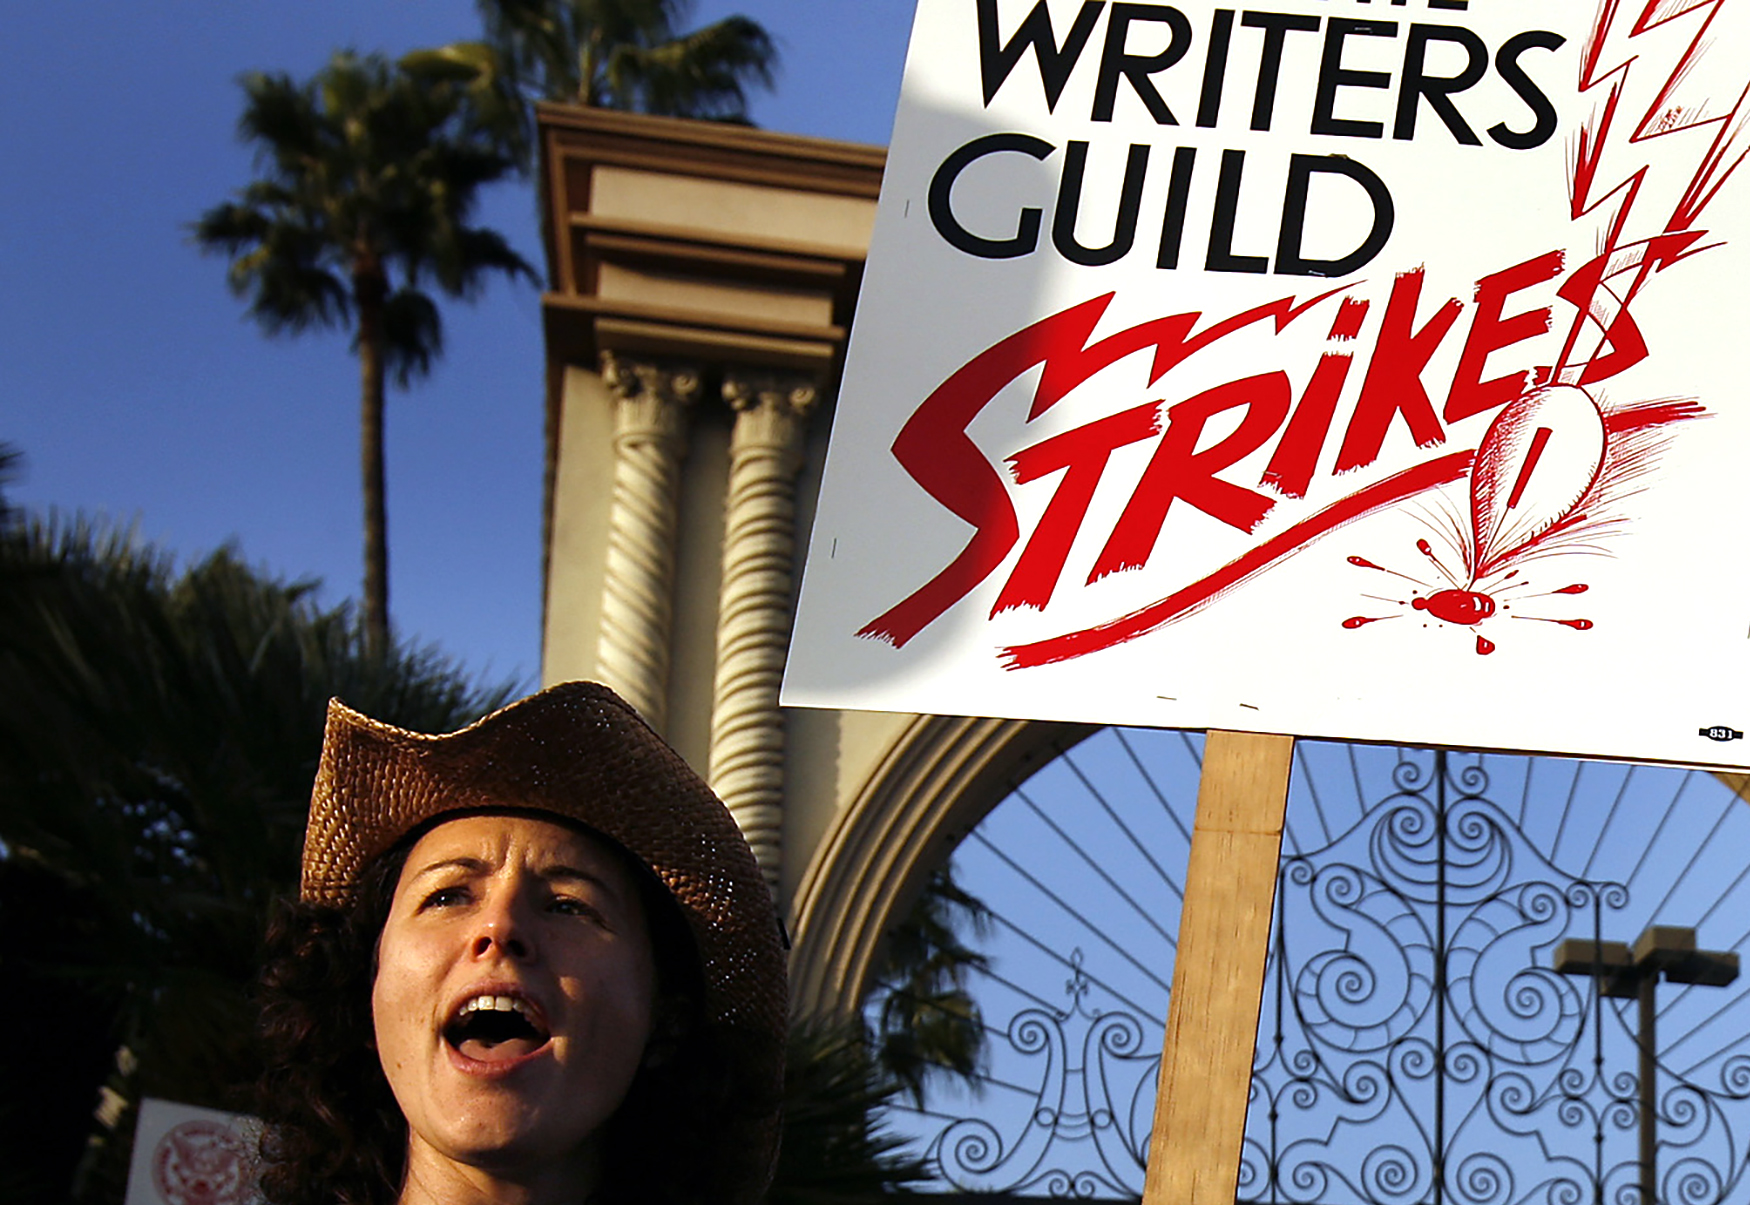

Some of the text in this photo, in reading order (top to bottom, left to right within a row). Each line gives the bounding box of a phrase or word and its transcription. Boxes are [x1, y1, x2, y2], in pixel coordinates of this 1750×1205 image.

[976, 0, 1567, 150] WRITERS
[927, 133, 1394, 278] GUILD
[853, 228, 1712, 649] STRIKES
[1709, 728, 1733, 739] 831
